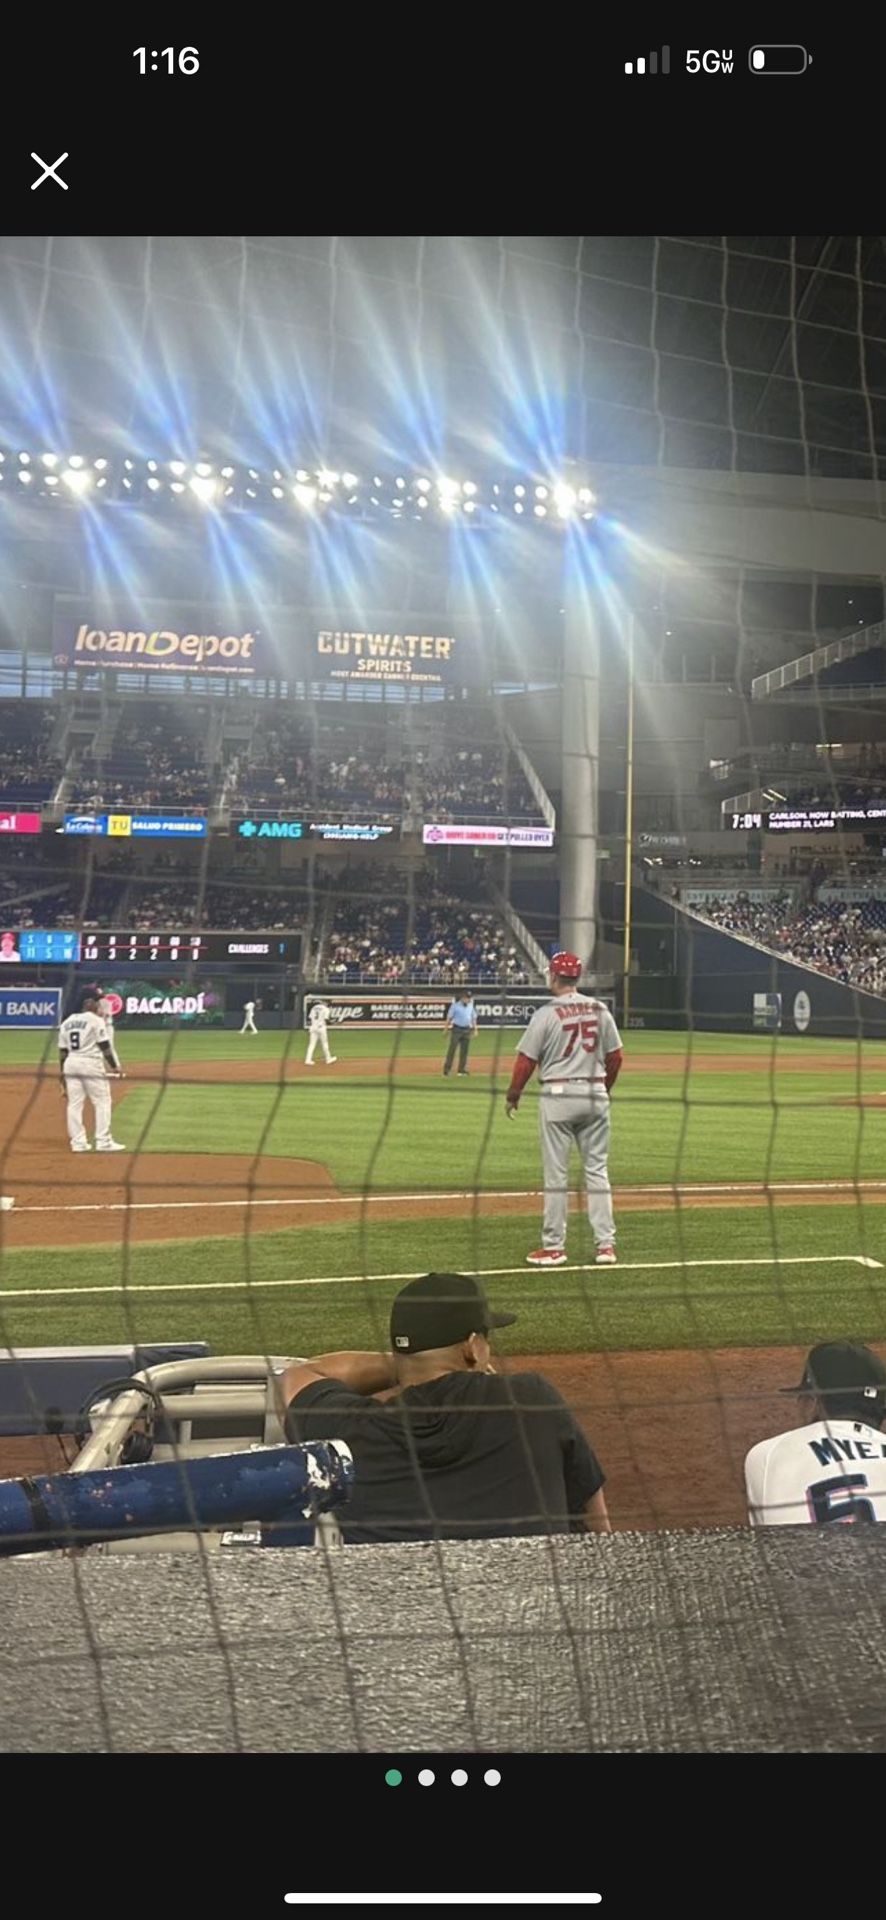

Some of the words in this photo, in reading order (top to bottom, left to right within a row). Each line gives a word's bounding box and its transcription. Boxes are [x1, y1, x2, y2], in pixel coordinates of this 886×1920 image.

[74, 624, 255, 662] loanDepot
[317, 631, 452, 659] CUTWATER
[357, 658, 412, 672] SPIRITS
[132, 821, 160, 830] SALUD
[162, 822, 204, 831] PRIMERO
[732, 813, 762, 829] 7:04
[768, 820, 801, 829] NUMBER
[813, 819, 835, 828] LARS
[258, 822, 303, 838] AMG
[129, 948, 137, 960] 2
[150, 948, 158, 960] 2
[228, 943, 269, 954] CHALLENGES
[6, 1001, 56, 1016] BANK
[126, 992, 206, 1014] BACARDÍ
[415, 1004, 446, 1012] CARDS
[70, 1031, 80, 1051] 9
[562, 1019, 598, 1058] 75
